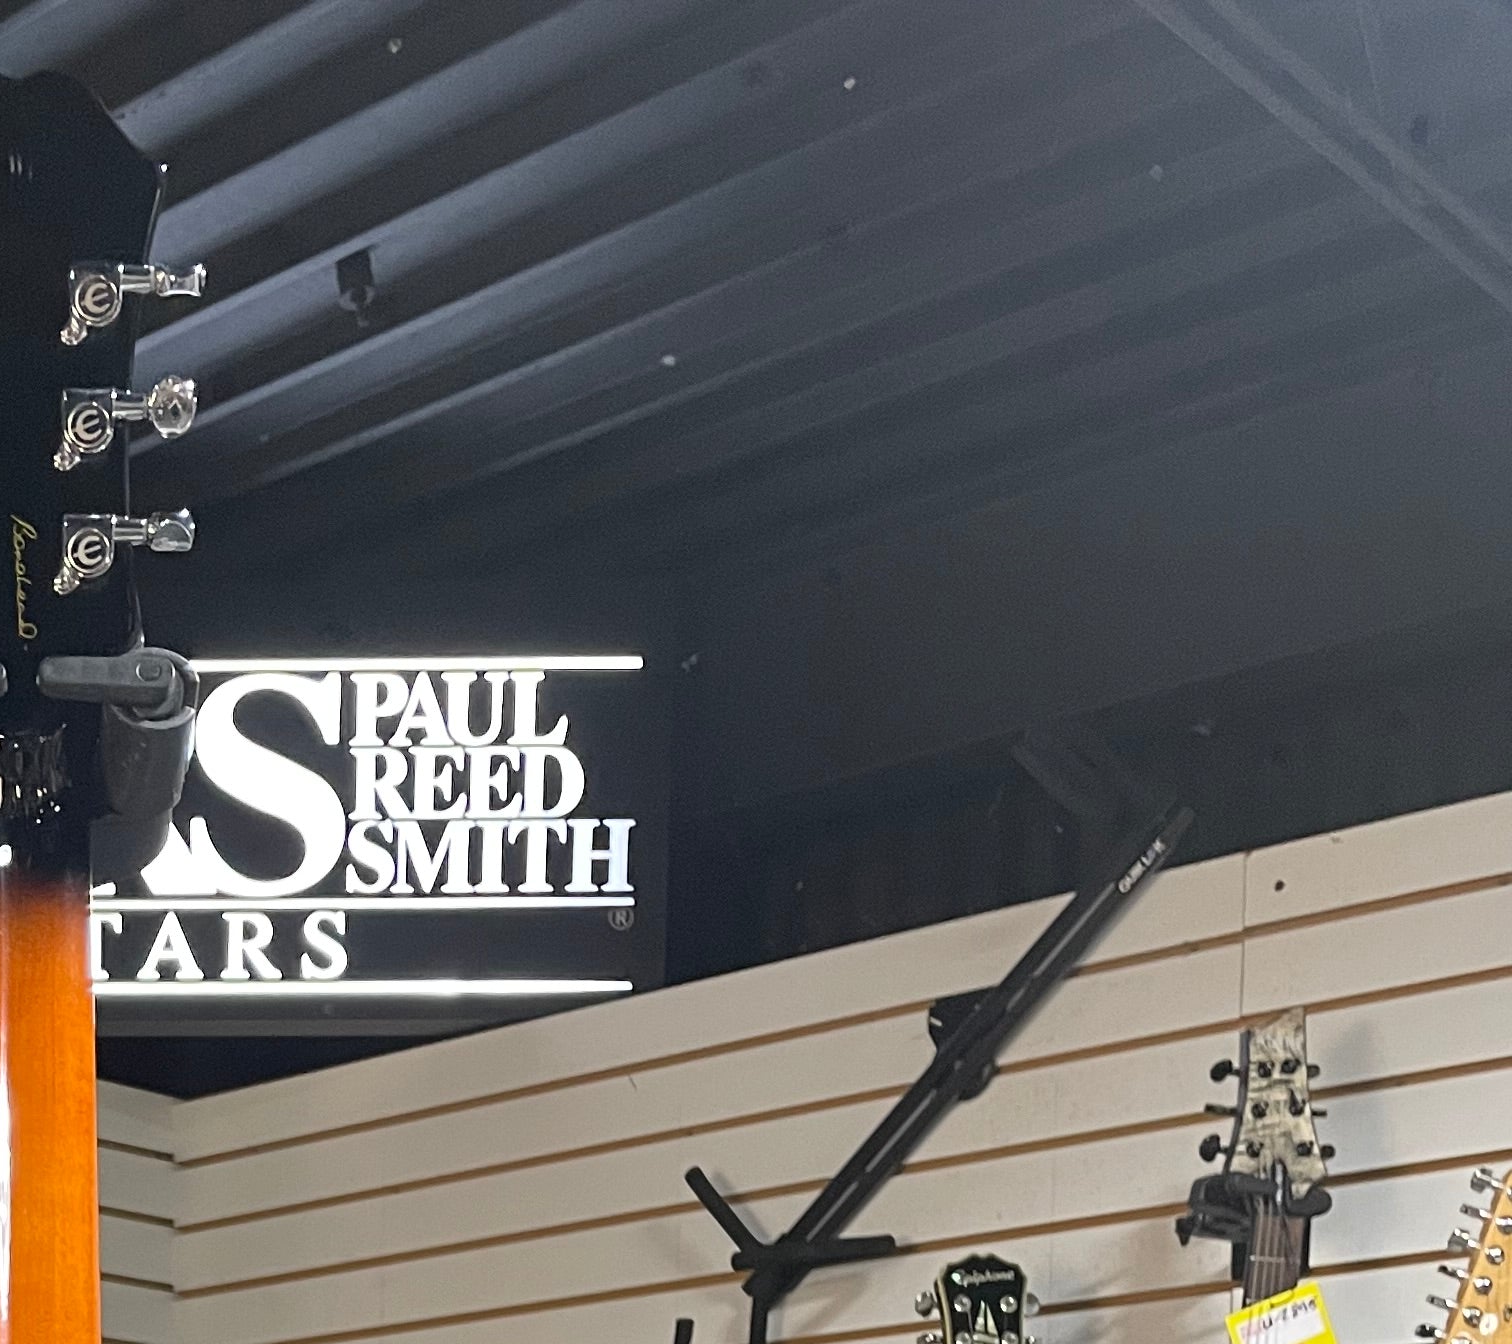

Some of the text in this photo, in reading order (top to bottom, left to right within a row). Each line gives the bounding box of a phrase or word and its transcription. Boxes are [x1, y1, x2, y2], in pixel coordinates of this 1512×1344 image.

[351, 669, 569, 747] PAUL
[347, 744, 587, 821] REED
[345, 818, 637, 896] SMITH
